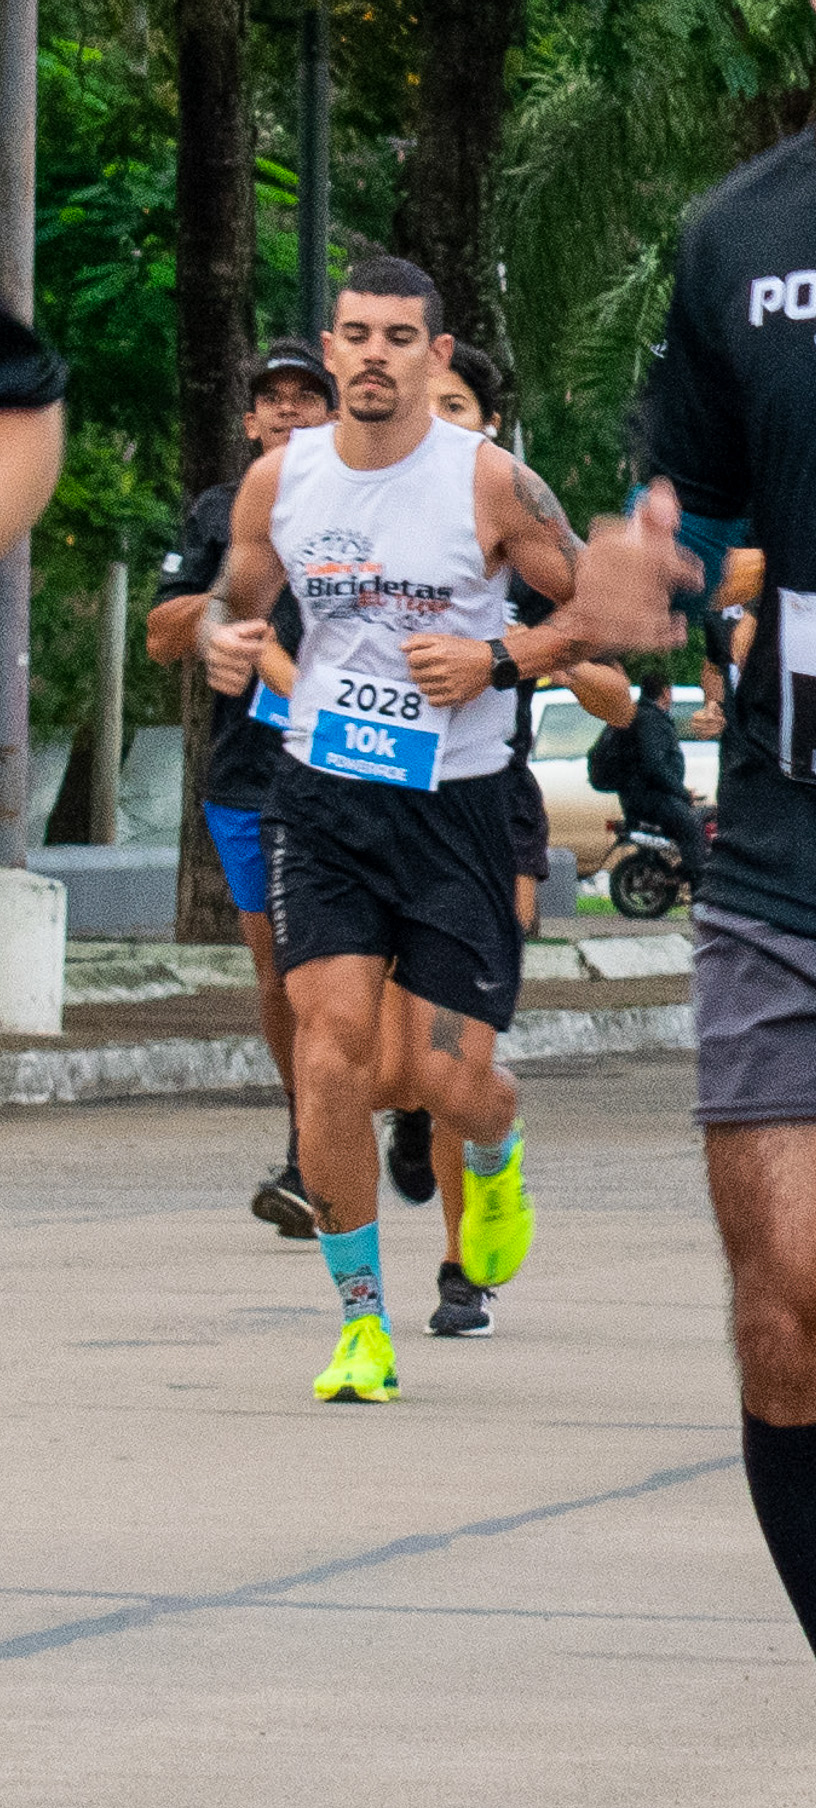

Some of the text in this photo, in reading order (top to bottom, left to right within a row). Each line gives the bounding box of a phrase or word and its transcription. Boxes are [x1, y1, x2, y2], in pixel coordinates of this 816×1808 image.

[306, 575, 453, 601] Bicicletas
[336, 679, 422, 721] 2028
[344, 722, 397, 758] 10k
